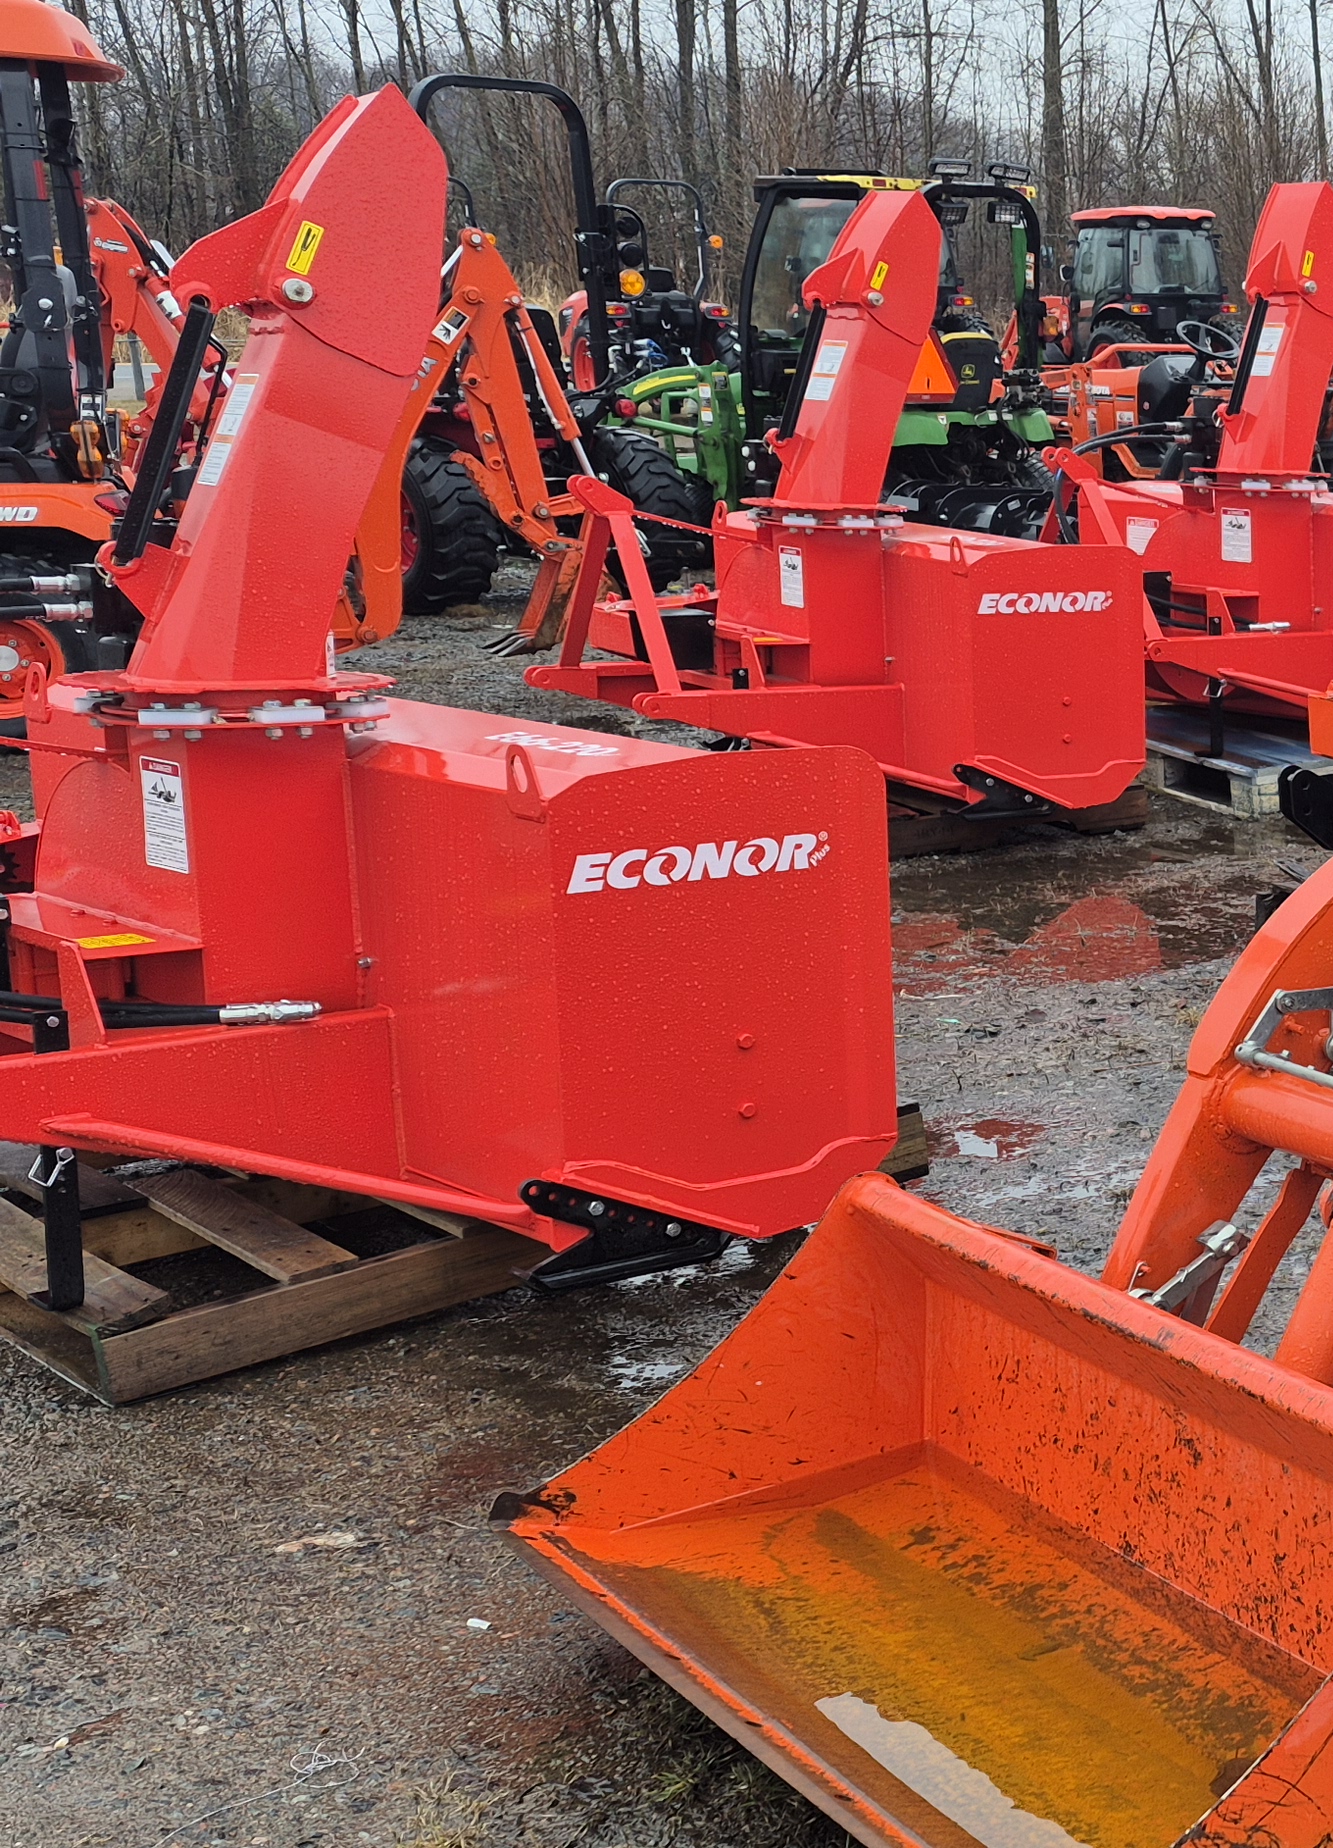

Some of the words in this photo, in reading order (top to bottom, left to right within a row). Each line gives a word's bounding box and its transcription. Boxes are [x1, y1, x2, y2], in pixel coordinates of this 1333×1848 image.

[0, 506, 38, 522] WD
[977, 591, 1106, 614] ECONOR
[566, 833, 817, 894] ECONOR
